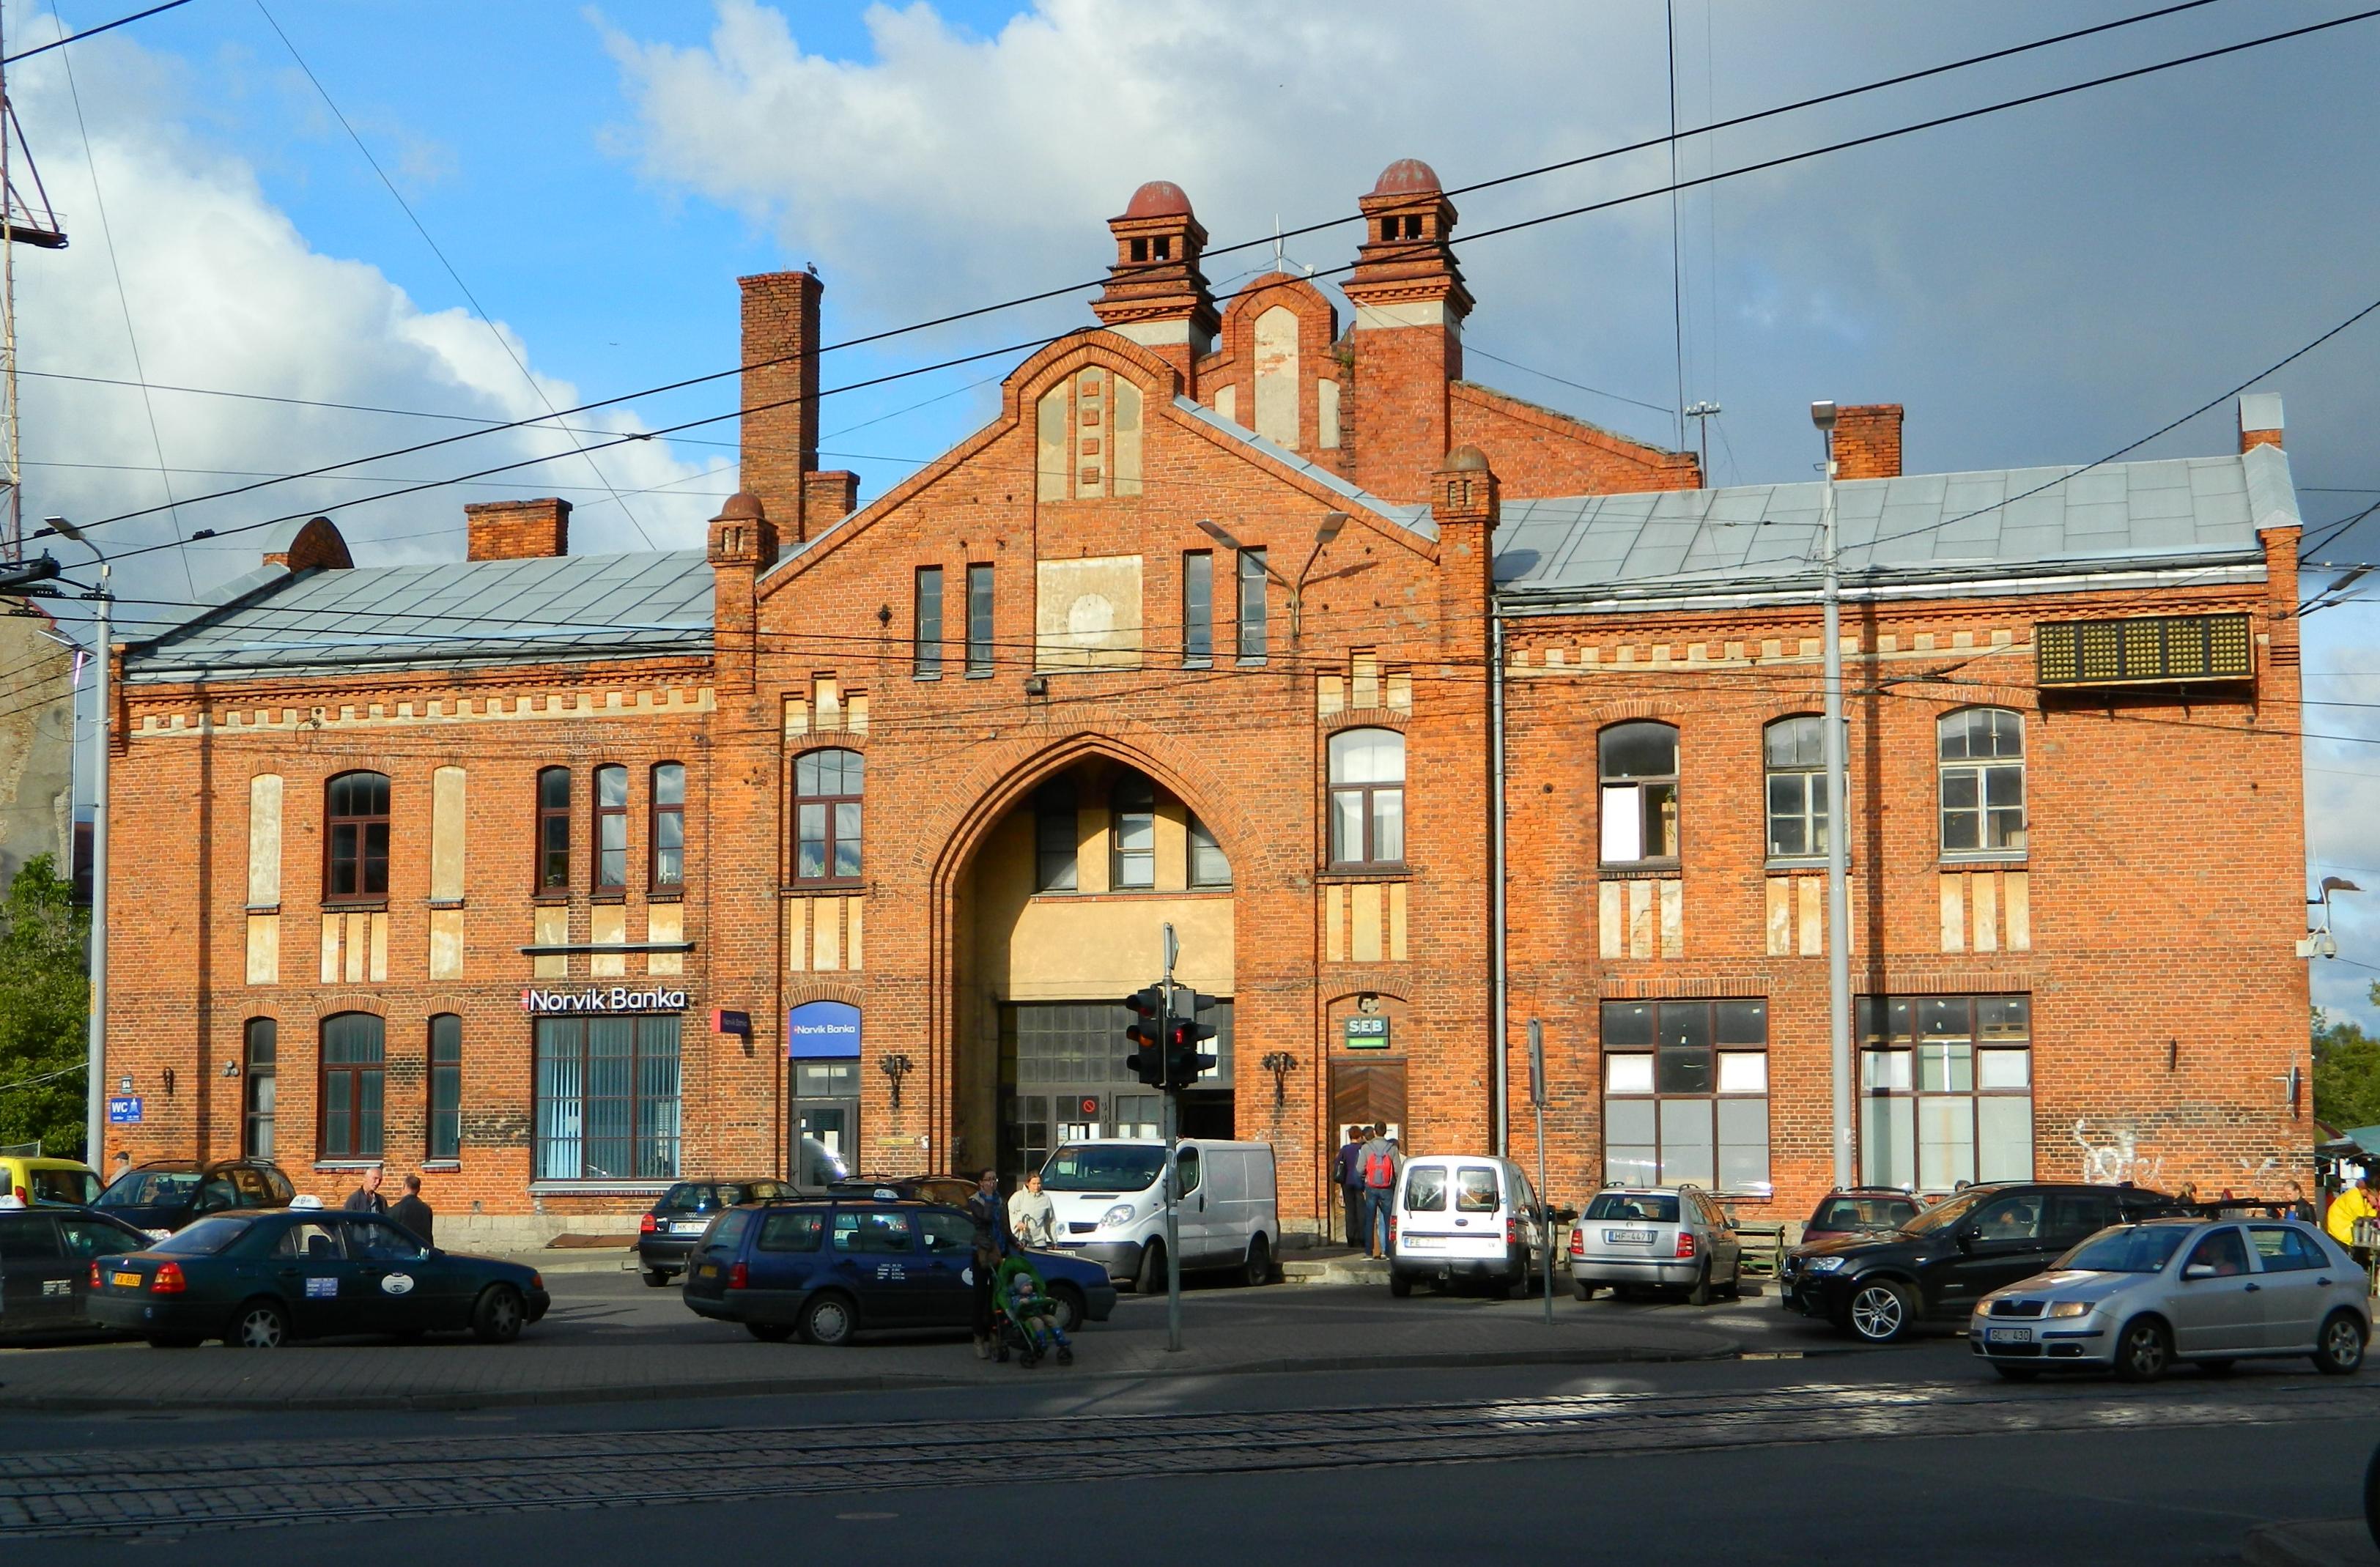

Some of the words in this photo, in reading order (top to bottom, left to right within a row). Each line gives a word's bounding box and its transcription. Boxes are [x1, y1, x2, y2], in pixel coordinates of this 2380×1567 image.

[530, 988, 606, 1011] Norvik
[611, 985, 685, 1010] Banka
[797, 1025, 826, 1034] Norvik
[827, 1024, 856, 1034] Banka
[1348, 1020, 1383, 1032] SEB
[111, 1101, 128, 1113] WC
[1614, 1231, 1652, 1241] HF-4471
[1992, 1330, 2029, 1340] GL-430
